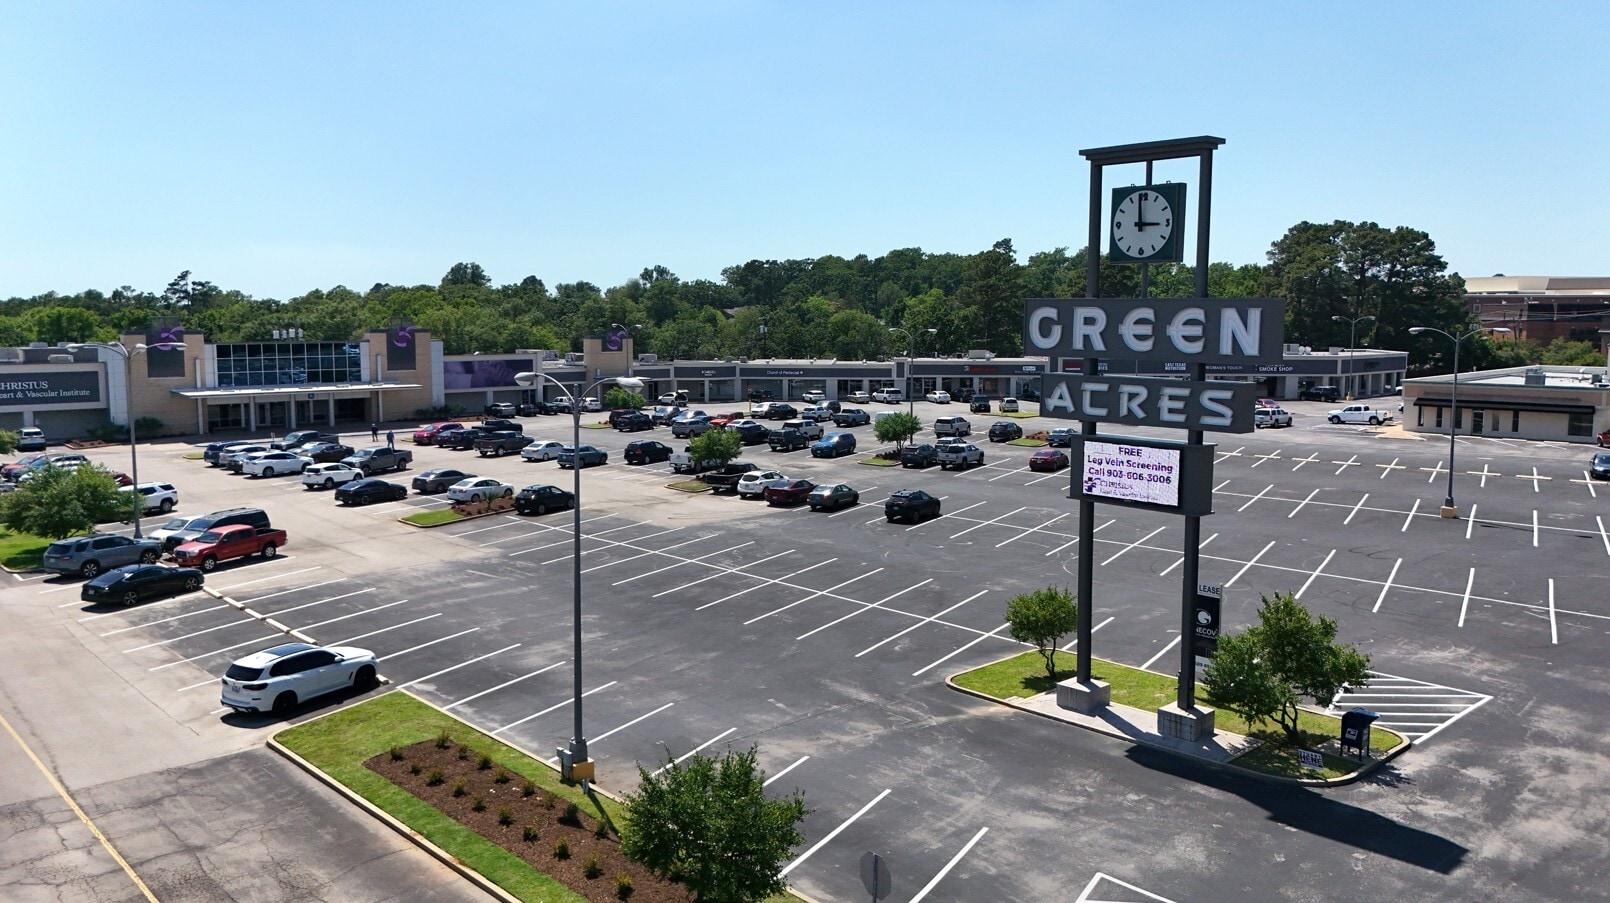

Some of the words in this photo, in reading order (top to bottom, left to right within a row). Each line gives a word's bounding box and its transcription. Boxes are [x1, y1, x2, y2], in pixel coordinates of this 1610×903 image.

[1115, 221, 1122, 230] 9
[1165, 218, 1170, 227] 3
[1138, 247, 1144, 256] 6
[1028, 306, 1262, 357] GREEN
[0, 381, 48, 390] HRISTUS
[25, 389, 58, 398] Vascular
[60, 388, 90, 396] Institute
[1045, 381, 1235, 427] ACRES
[1119, 447, 1142, 457] FREE
[1088, 455, 1103, 465] Leg
[1105, 457, 1124, 466] Vein
[1126, 460, 1173, 474] Screening
[1088, 467, 1105, 476] Call
[1106, 469, 1172, 484] 903-606-3006
[1199, 585, 1220, 595] LEASE
[1196, 626, 1217, 636] NECOV
